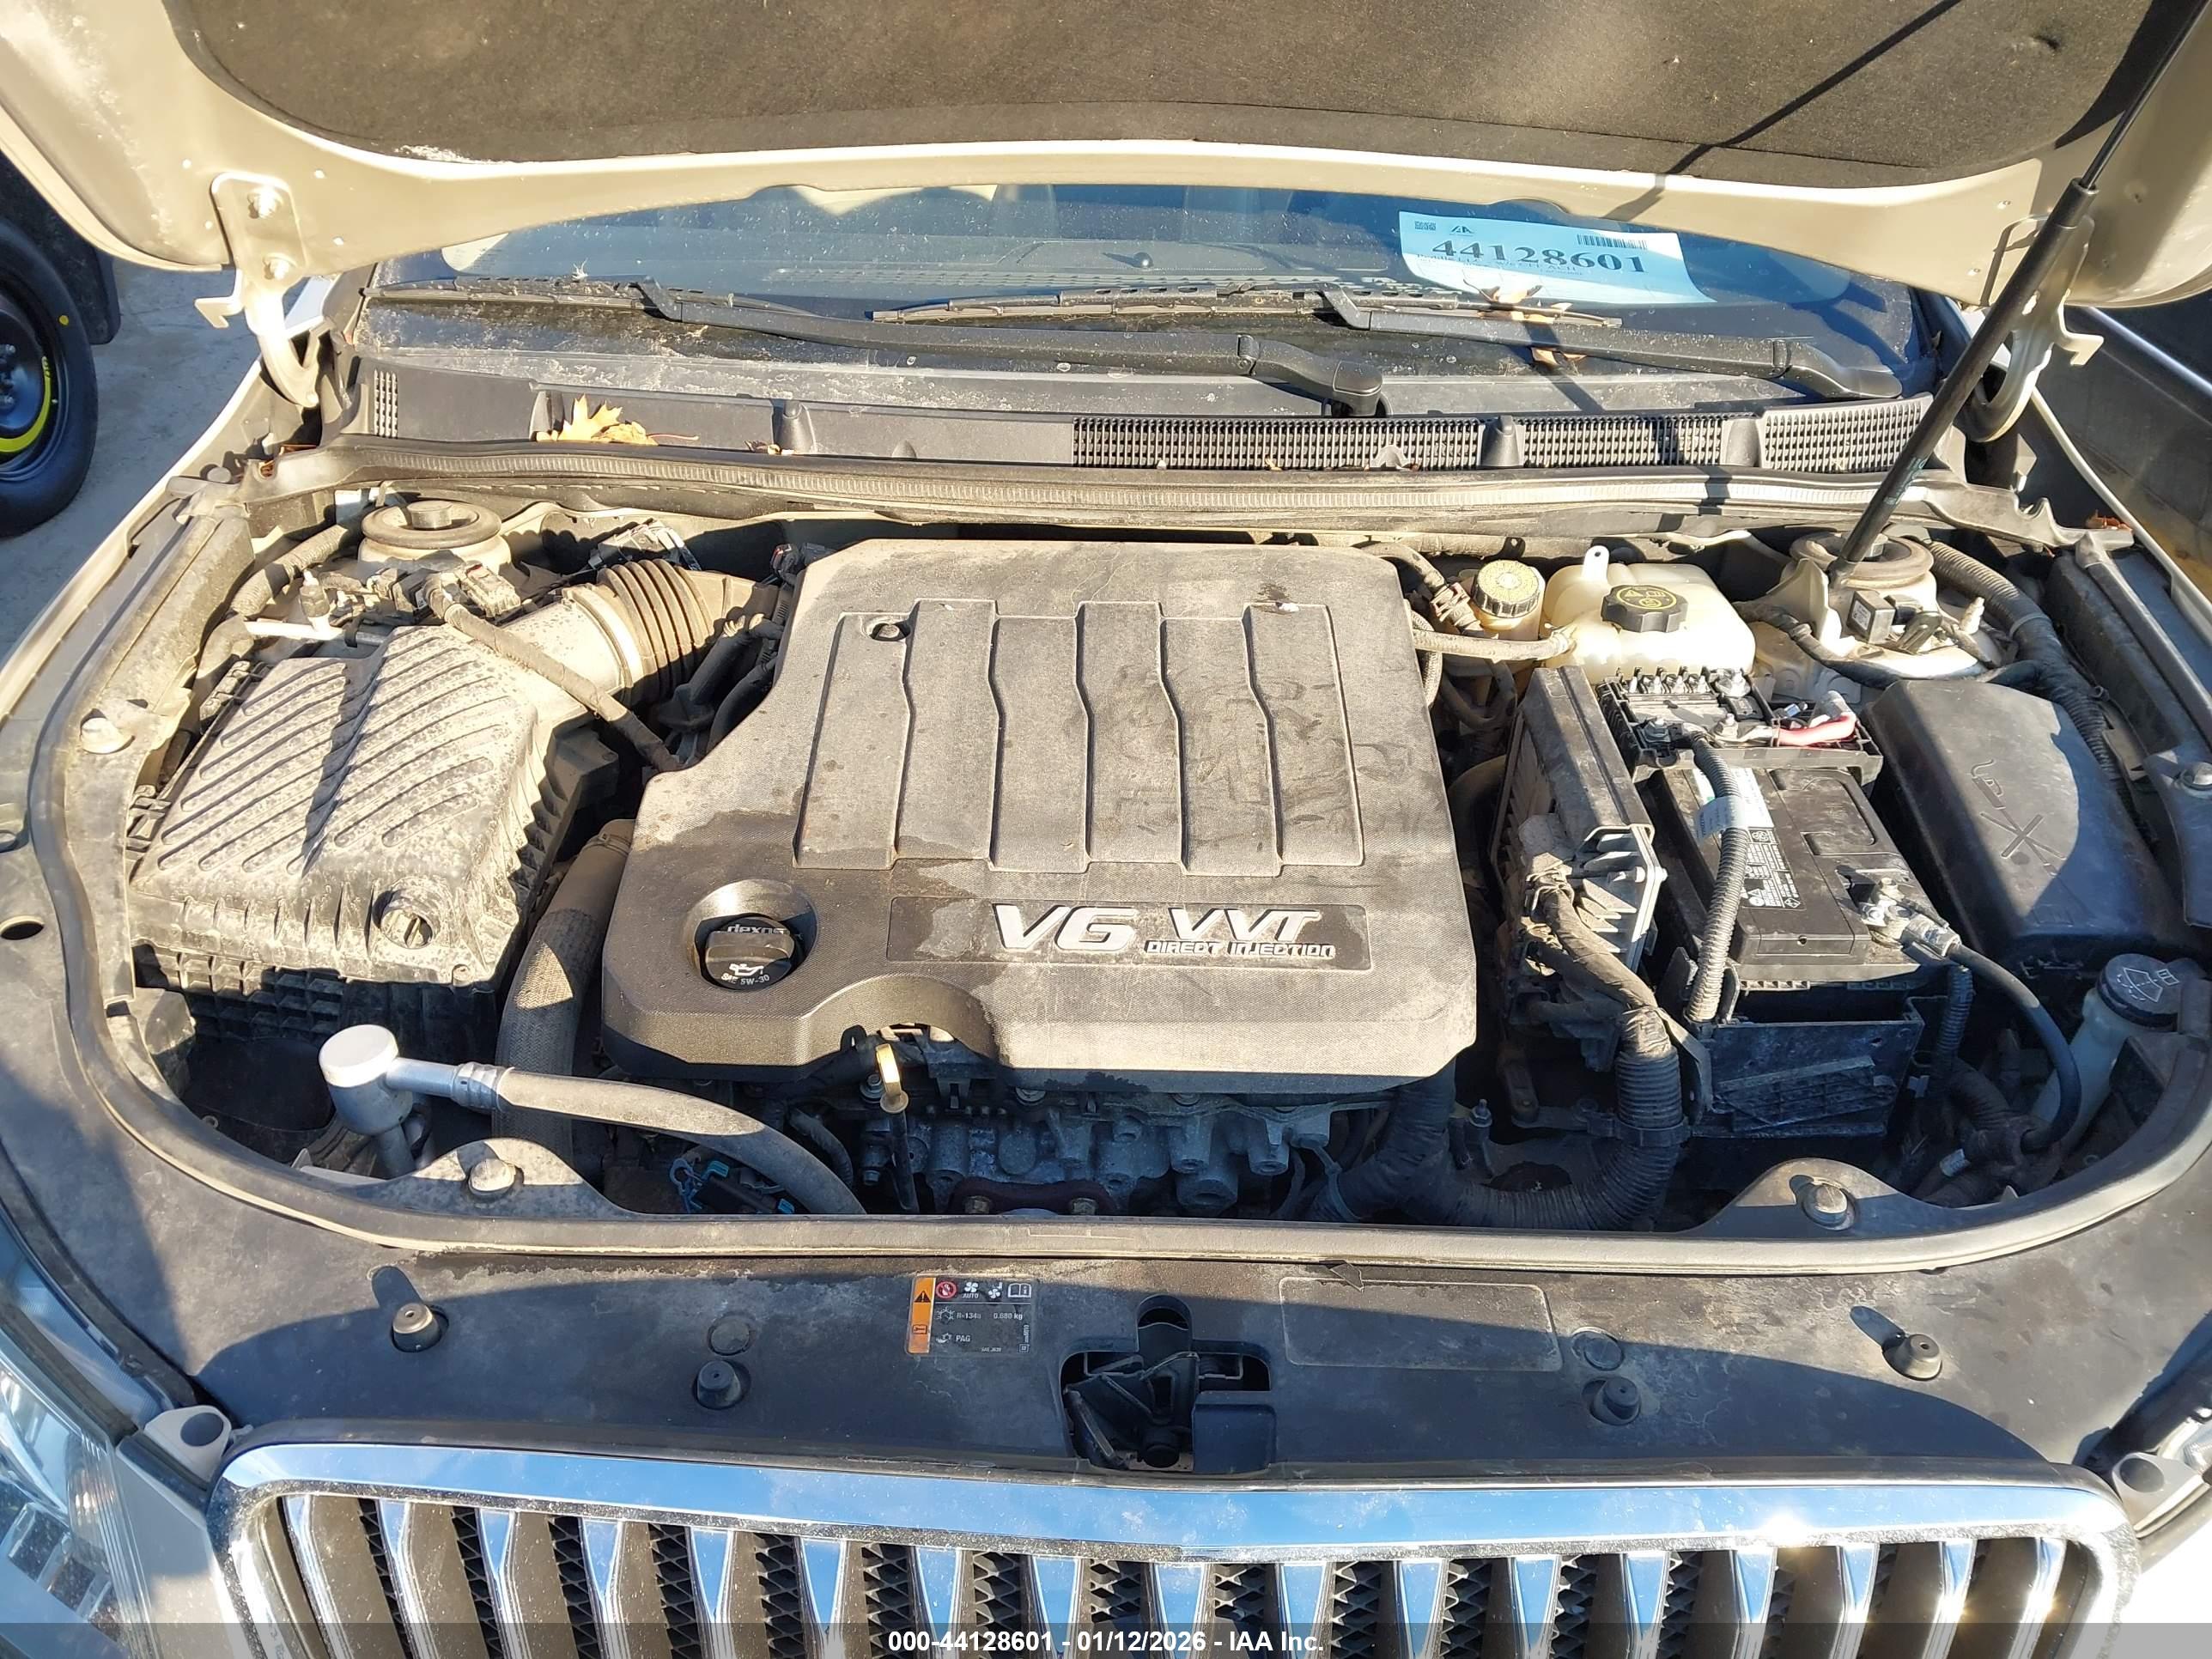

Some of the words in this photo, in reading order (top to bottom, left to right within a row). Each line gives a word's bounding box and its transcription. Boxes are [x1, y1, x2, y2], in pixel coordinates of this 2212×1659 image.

[1432, 240, 1646, 273] 44128601
[993, 902, 1140, 952] V6
[1167, 907, 1322, 942] VVT
[1145, 939, 1217, 956] DIRECT
[1227, 941, 1336, 957] INJECTION
[720, 972, 738, 985] SAE
[740, 974, 770, 985] 5W-30
[1013, 1312, 1024, 1321] kg
